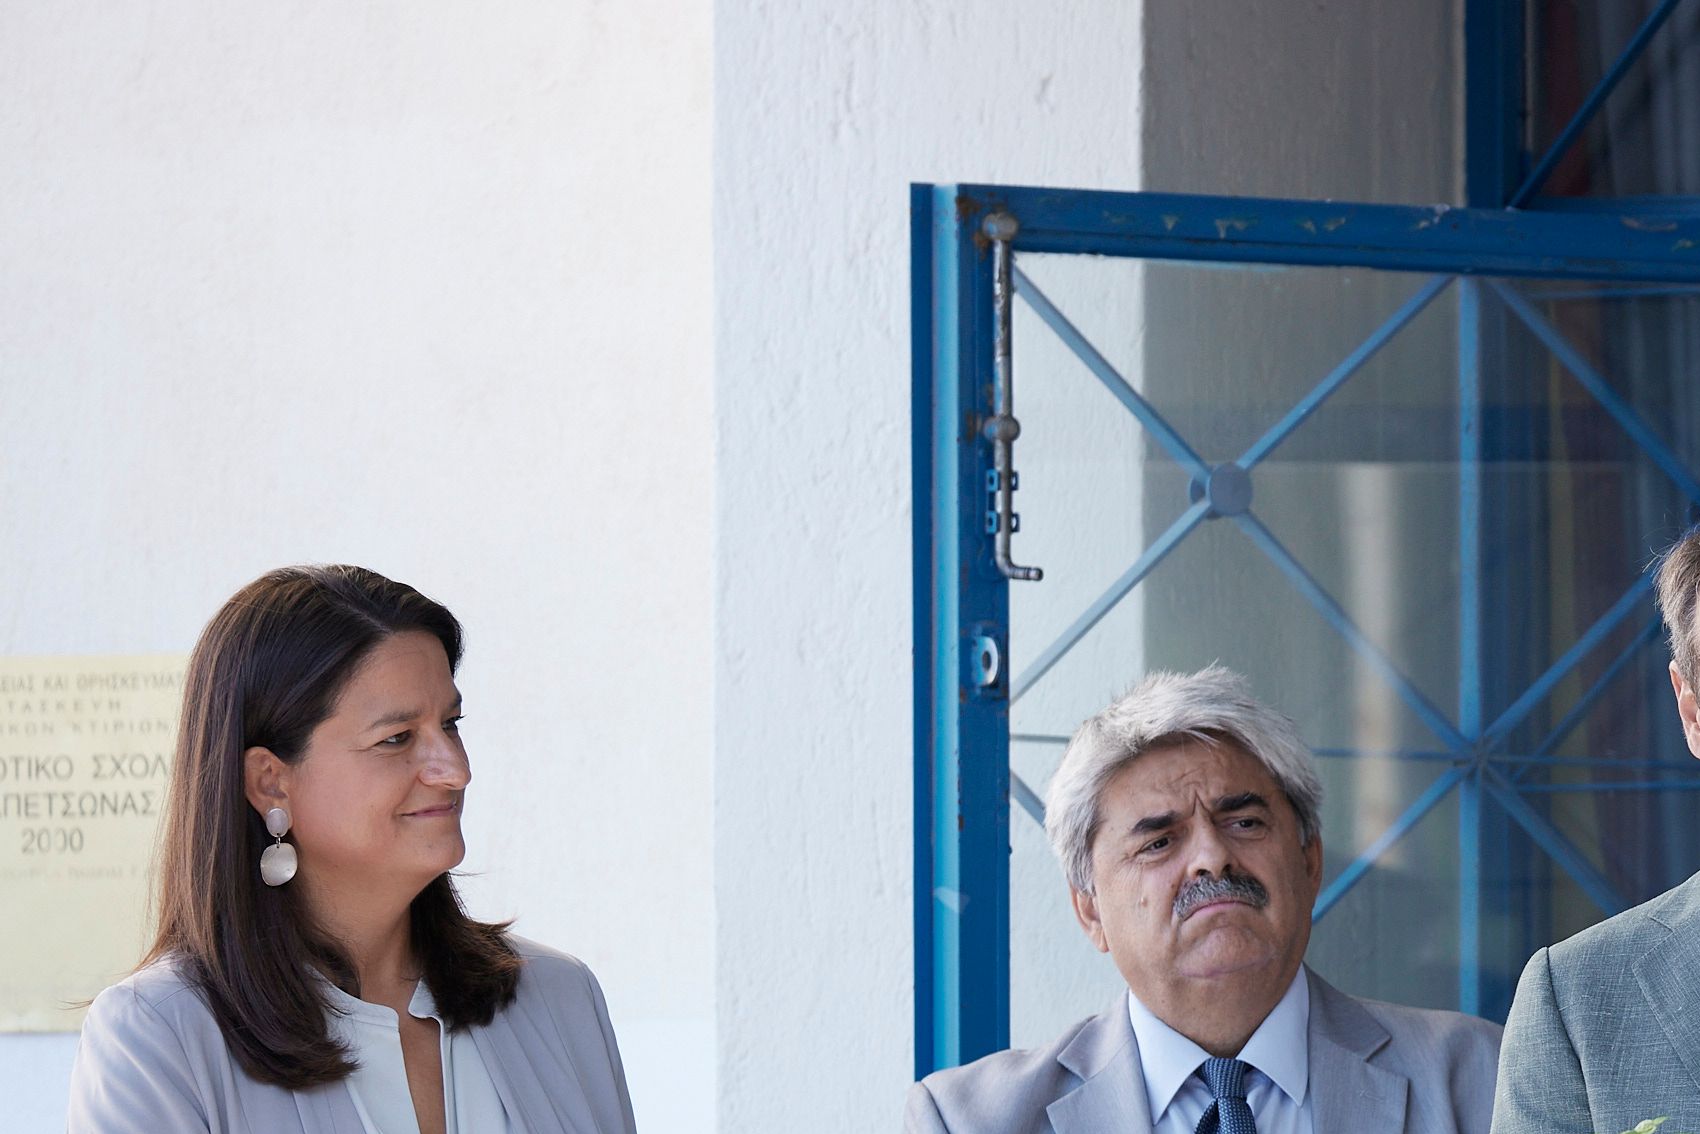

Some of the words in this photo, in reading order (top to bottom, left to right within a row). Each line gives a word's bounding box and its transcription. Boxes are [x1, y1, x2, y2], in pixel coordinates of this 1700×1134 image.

[43, 673, 69, 692] ΚΑΙ
[92, 753, 168, 780] ΣΧΟΛ
[0, 790, 157, 819] ΠΕΤΣΩΝΑΣ
[21, 828, 84, 855] 2000
